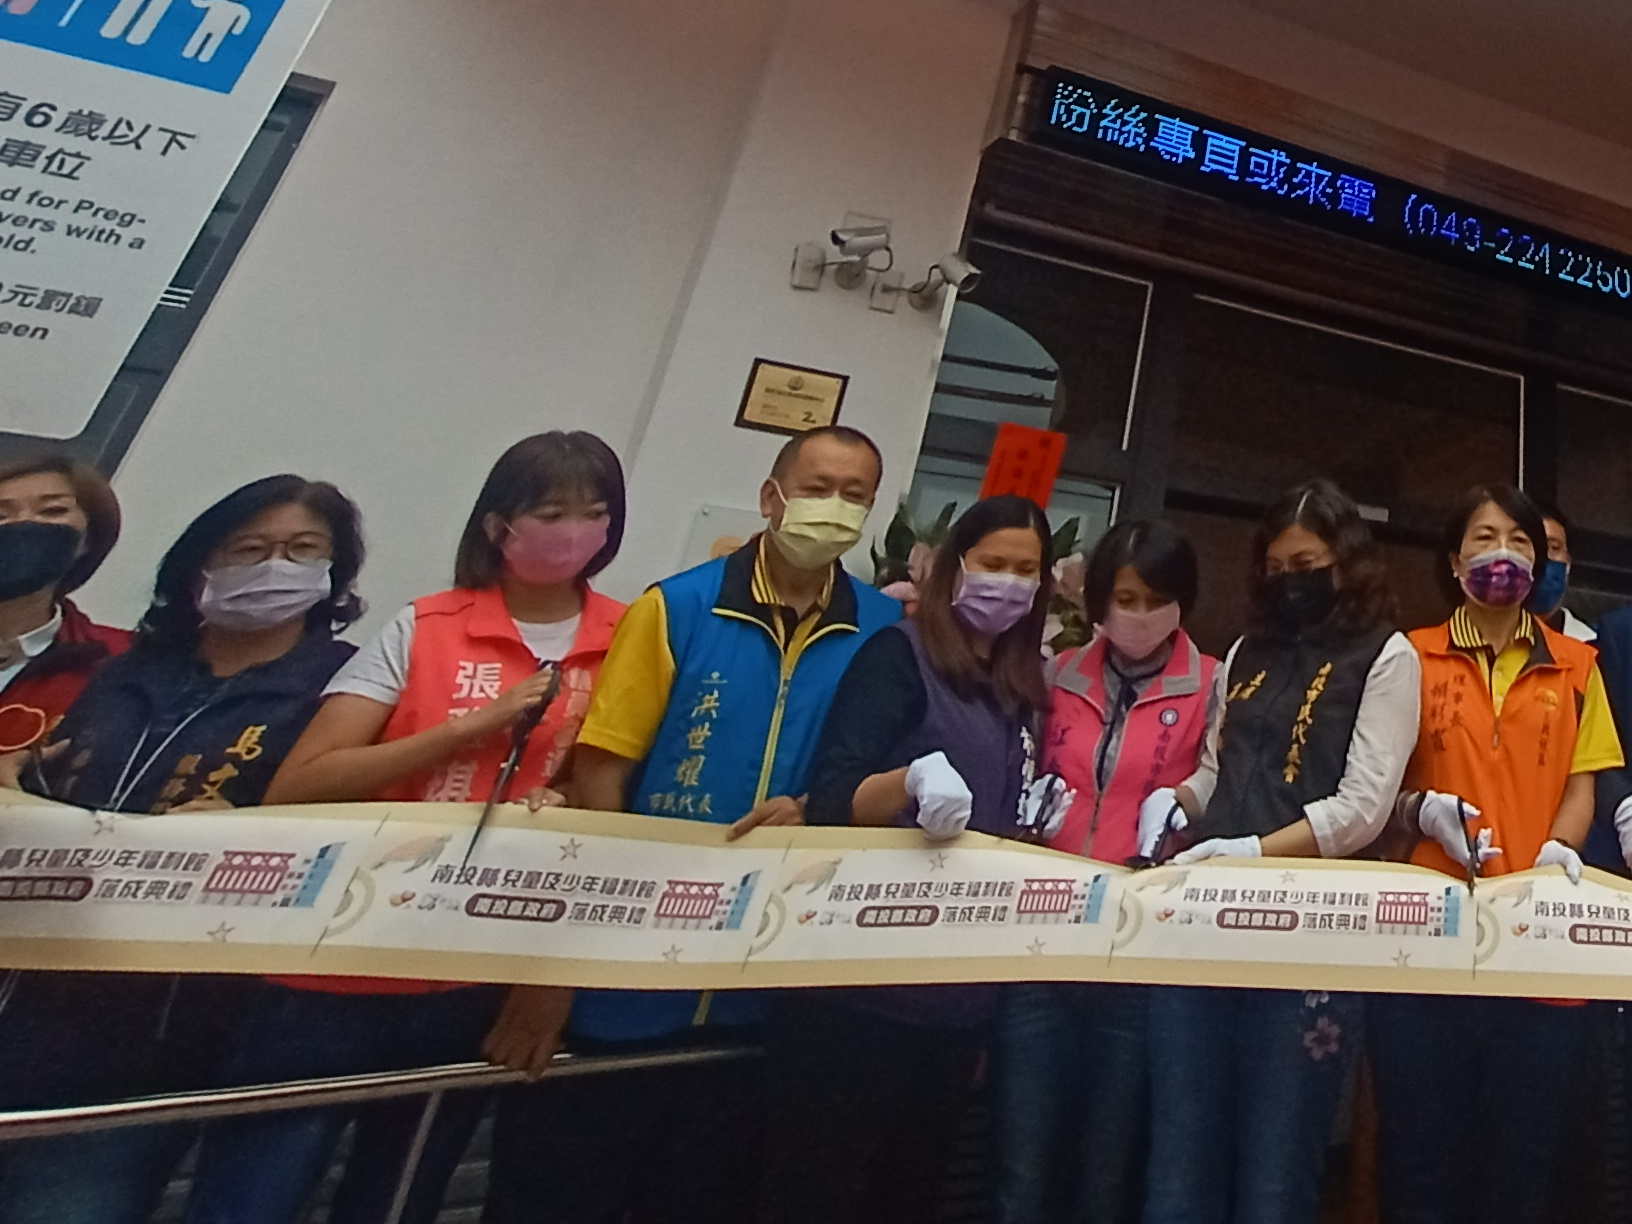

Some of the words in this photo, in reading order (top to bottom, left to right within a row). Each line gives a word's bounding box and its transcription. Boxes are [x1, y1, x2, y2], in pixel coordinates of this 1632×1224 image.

[26, 190, 69, 210] for
[73, 199, 146, 226] Preg-
[0, 233, 36, 254] ld.
[66, 224, 121, 246] with
[128, 237, 145, 250] a
[0, 282, 103, 319] 元罰鍰
